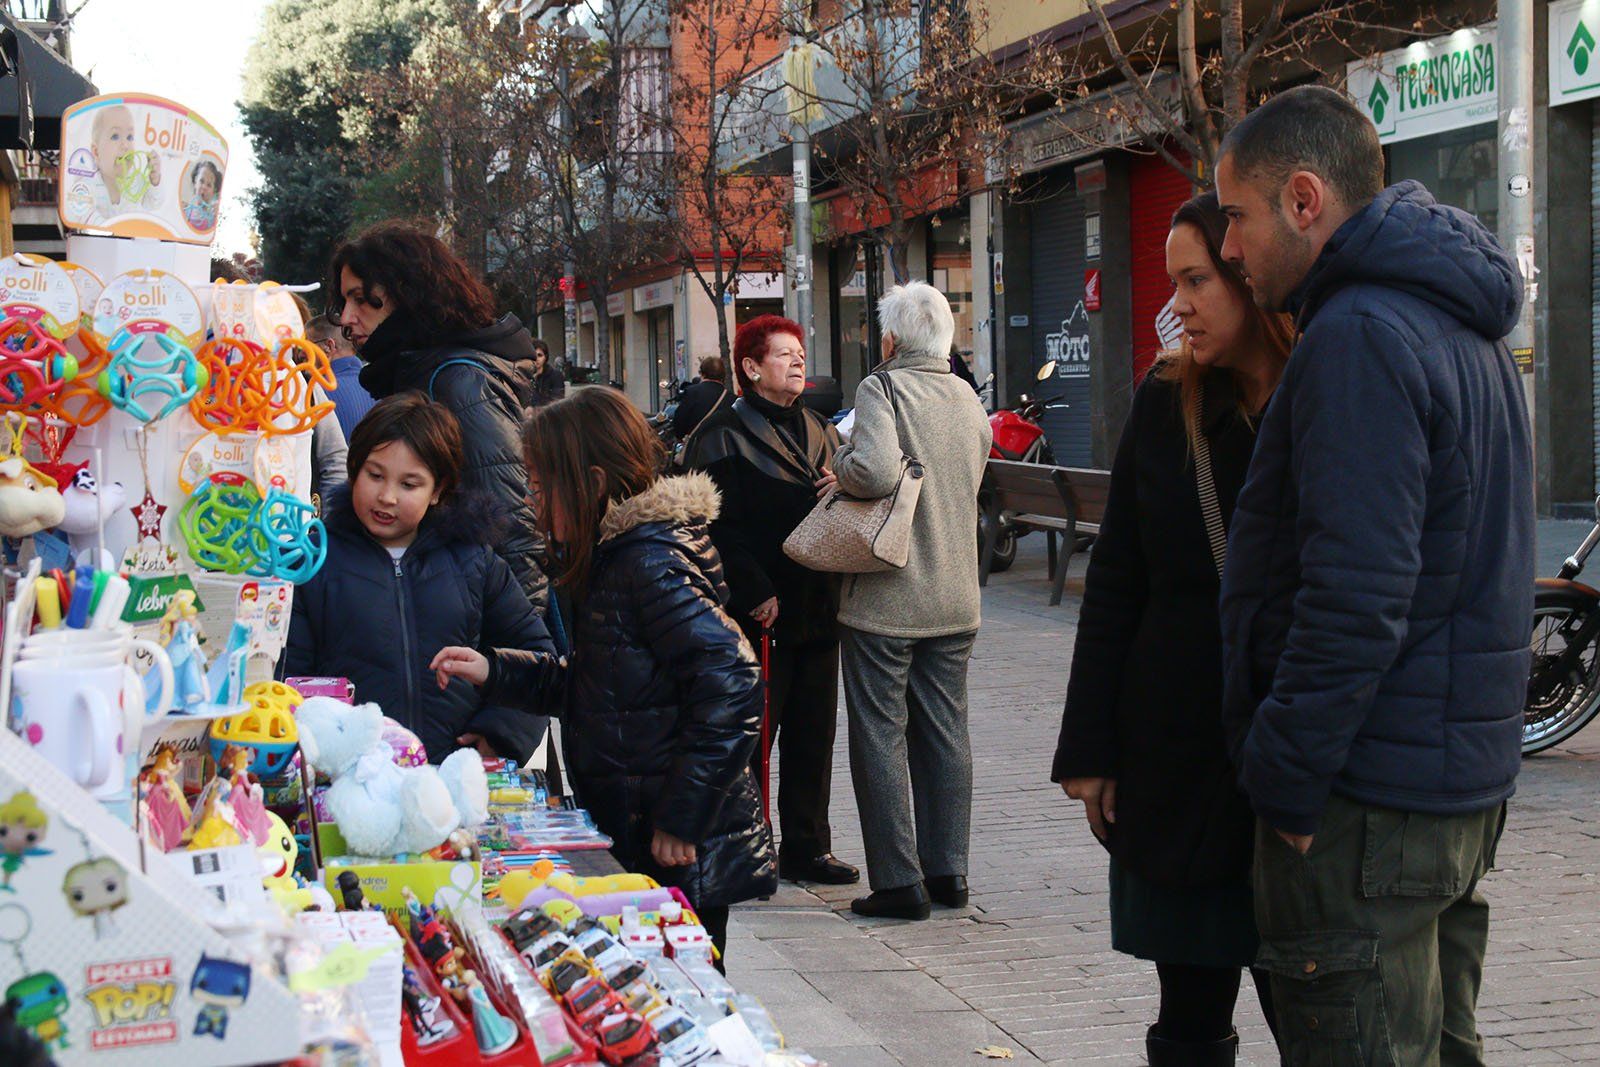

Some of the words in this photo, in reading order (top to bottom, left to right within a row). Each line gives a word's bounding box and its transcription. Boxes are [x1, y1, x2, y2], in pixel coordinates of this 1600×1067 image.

[145, 113, 187, 152] bolli
[124, 284, 167, 306] bolli
[1046, 334, 1090, 362] MOTO
[213, 444, 245, 461] bolli
[85, 982, 176, 1028] POP!
